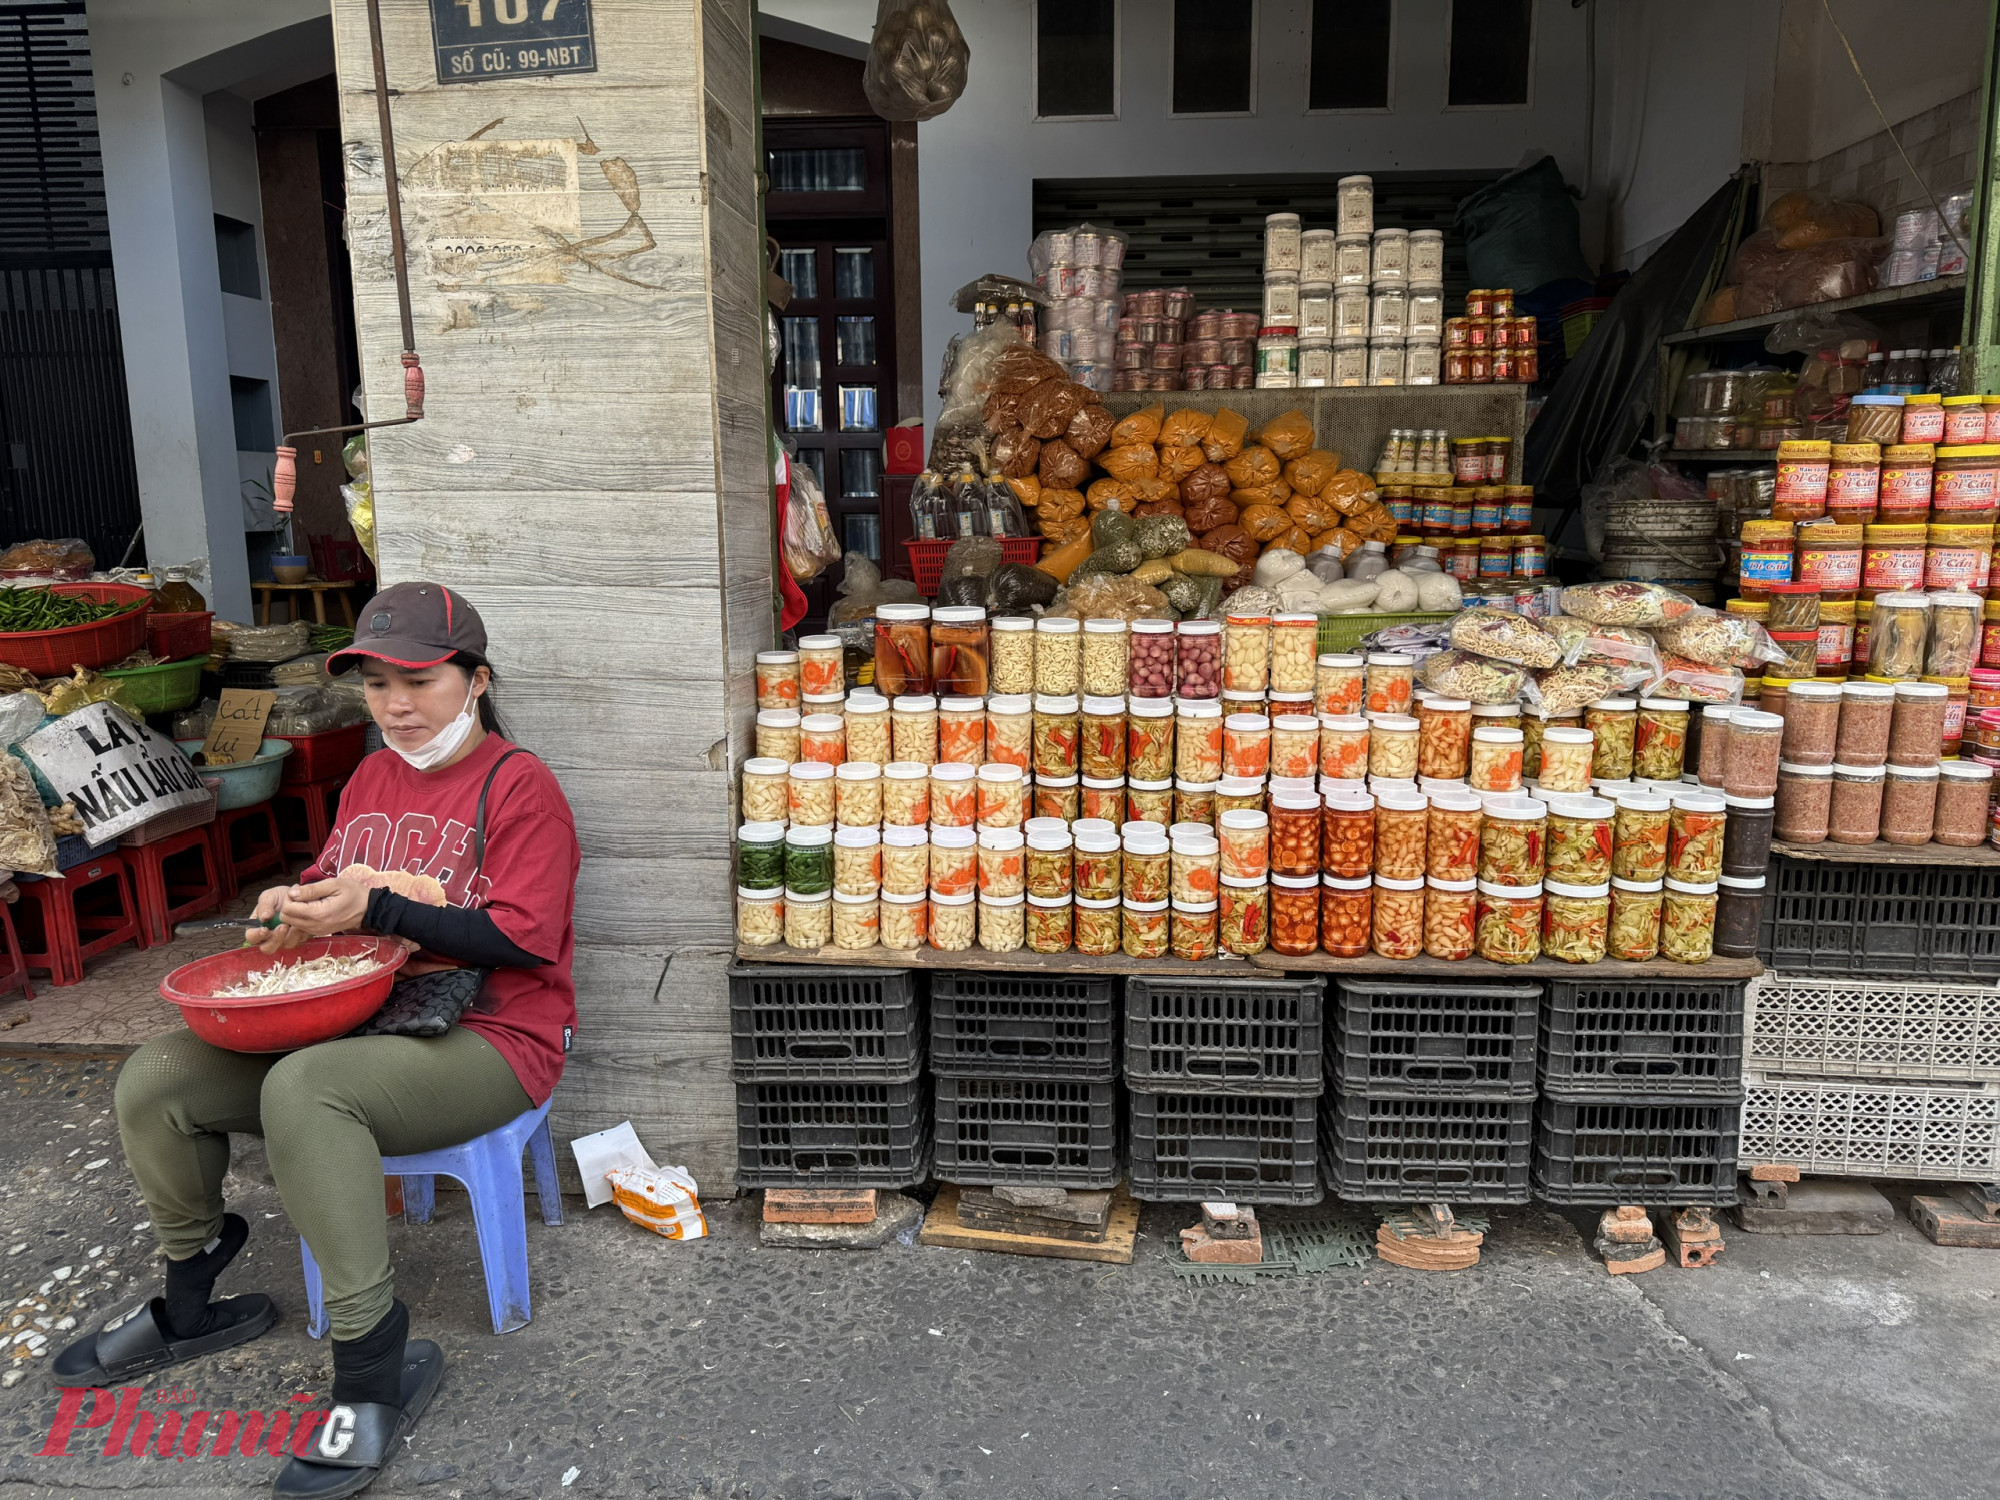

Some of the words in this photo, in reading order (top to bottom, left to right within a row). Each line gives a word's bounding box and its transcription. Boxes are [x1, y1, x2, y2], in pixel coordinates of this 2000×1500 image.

[452, 47, 475, 74] SỐ
[482, 49, 511, 71] CŨ:
[518, 46, 581, 69] 99-NBT
[75, 708, 136, 757] LÁ
[220, 696, 262, 721] Cát
[66, 762, 149, 830] NẤU
[134, 743, 184, 798] LẨU
[169, 747, 205, 790] GÀ
[319, 1405, 357, 1458] G
